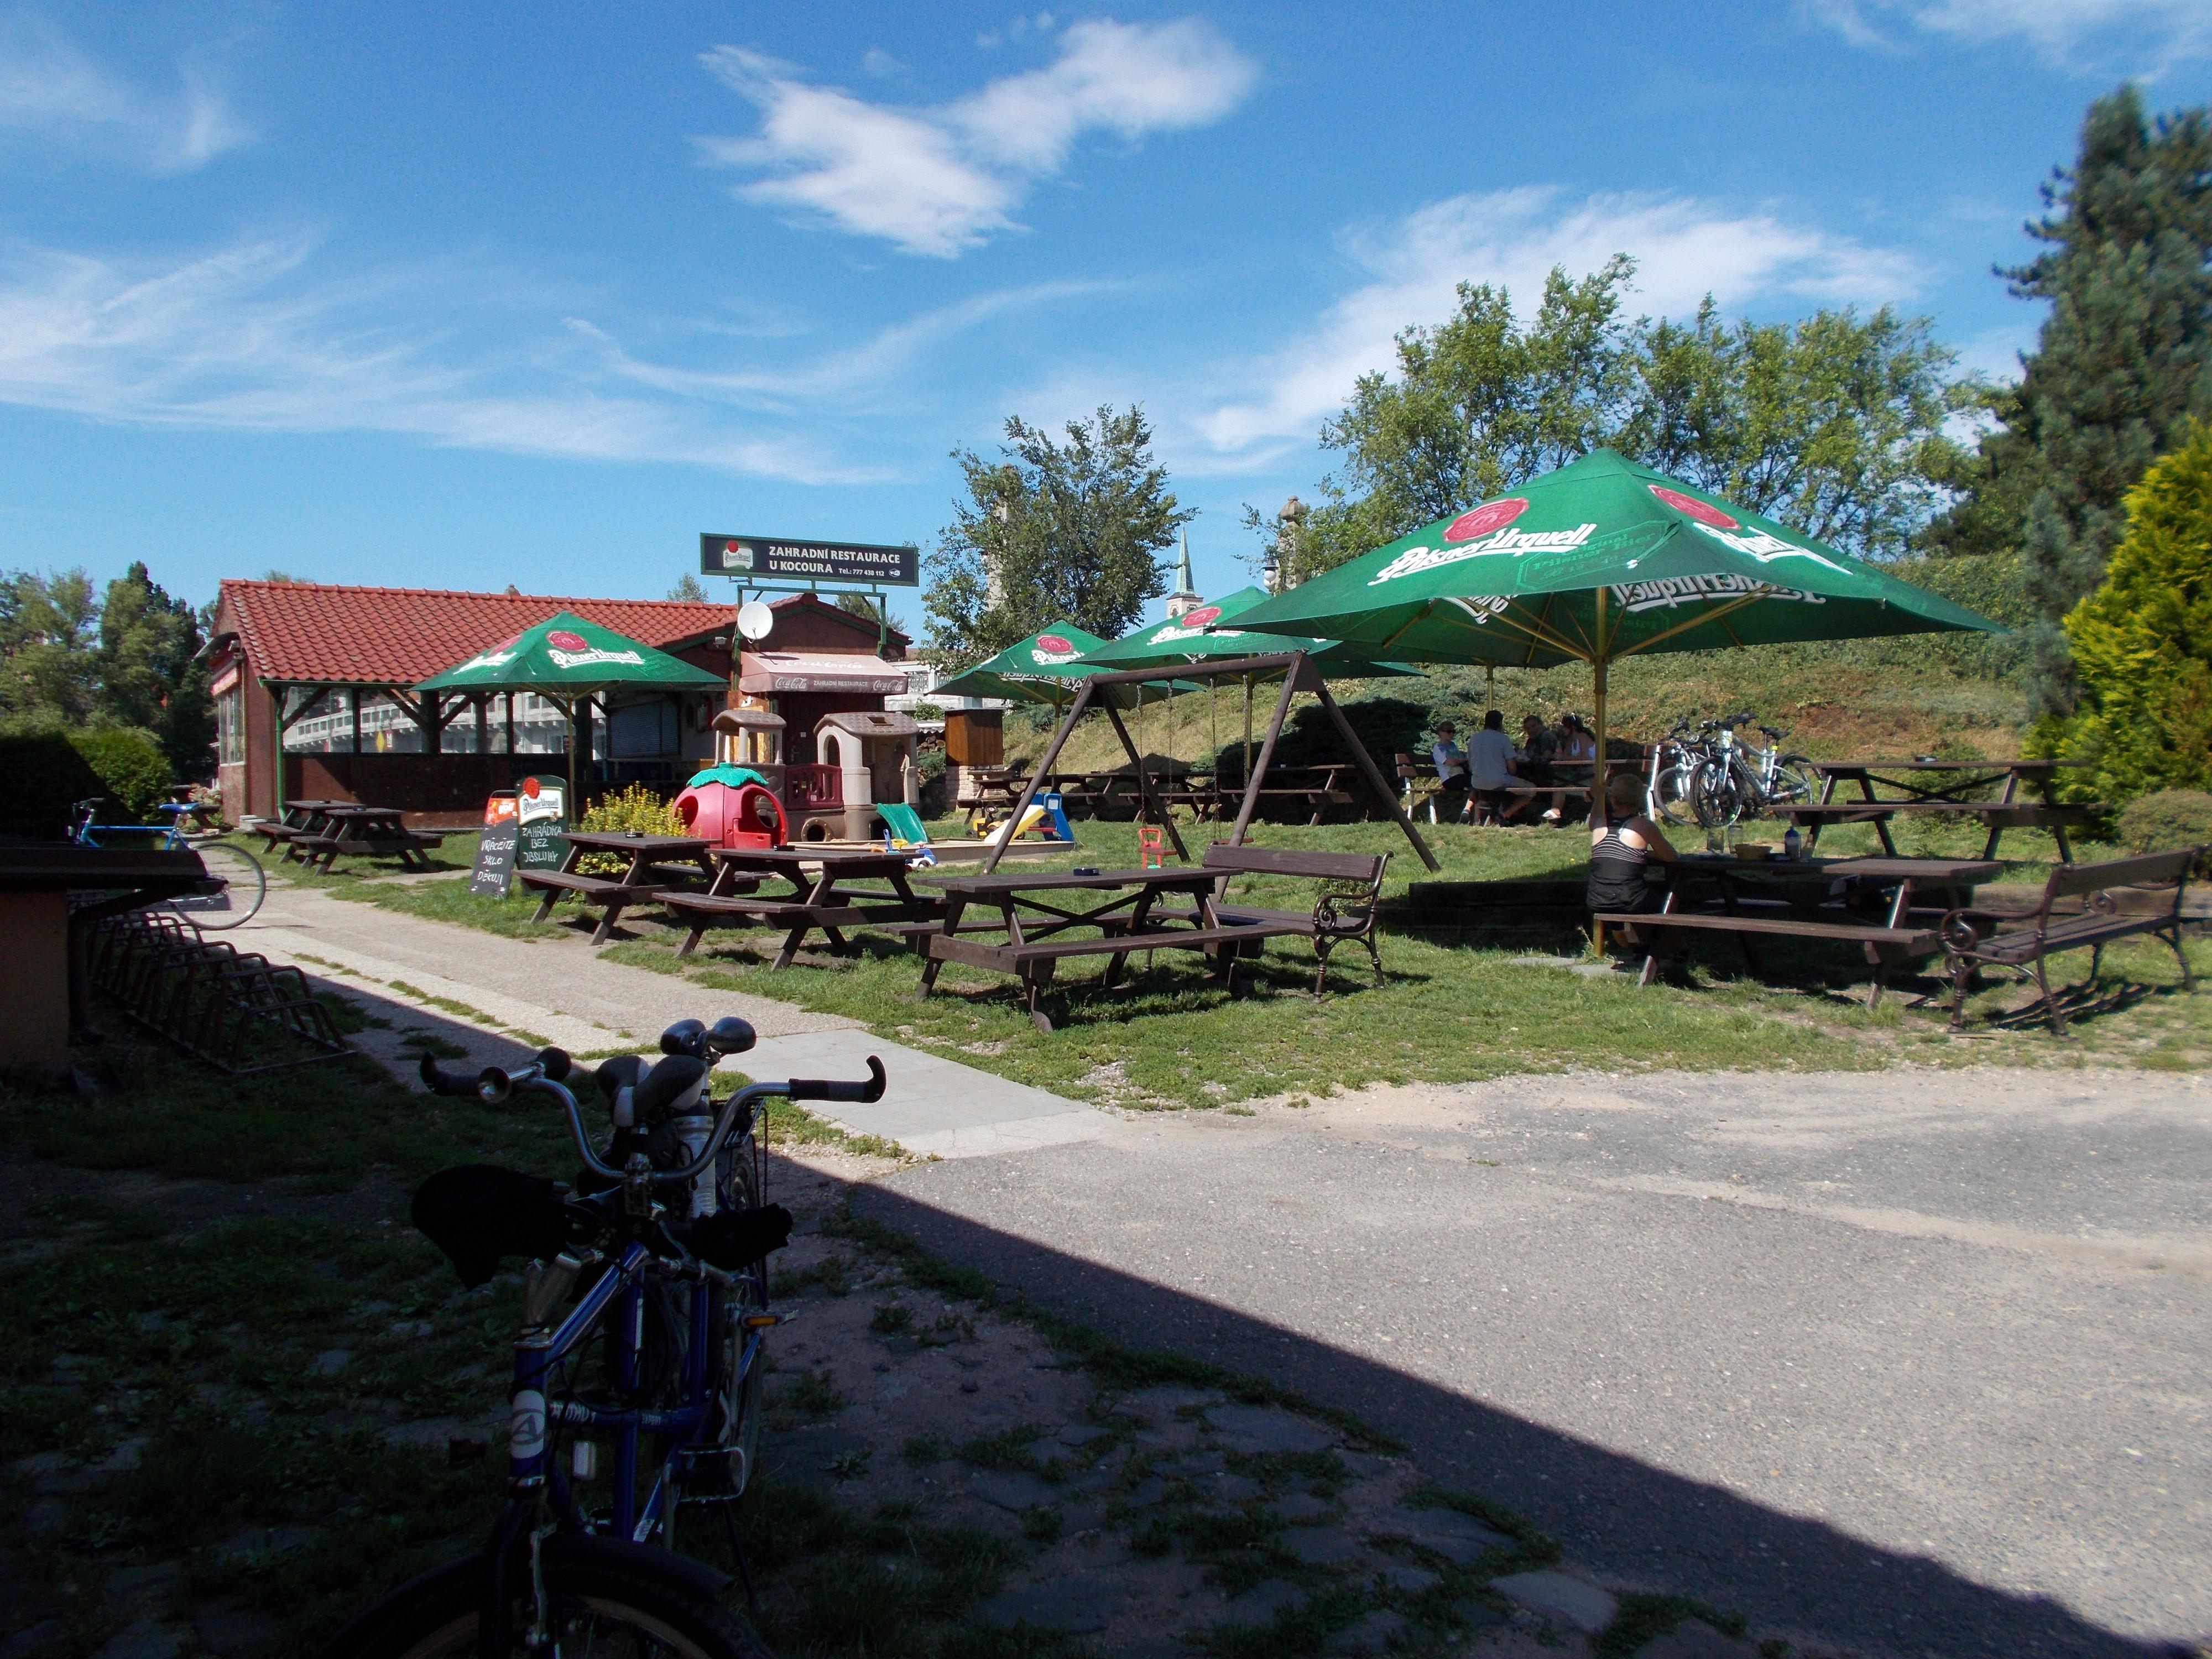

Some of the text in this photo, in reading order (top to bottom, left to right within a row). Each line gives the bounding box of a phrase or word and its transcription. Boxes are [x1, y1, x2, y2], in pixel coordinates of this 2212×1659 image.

[769, 546, 900, 564] ZAHRADNÍ RESTAURACE
[1367, 539, 1494, 586] Pilsner
[769, 560, 833, 573] U KOCOURA
[547, 648, 646, 668] Pilsner Urquell
[1031, 650, 1077, 665] Pilsner
[523, 798, 542, 815] Pilsner
[540, 798, 559, 809] Urquell
[531, 838, 549, 849] BEZ
[483, 855, 503, 865] SKLO
